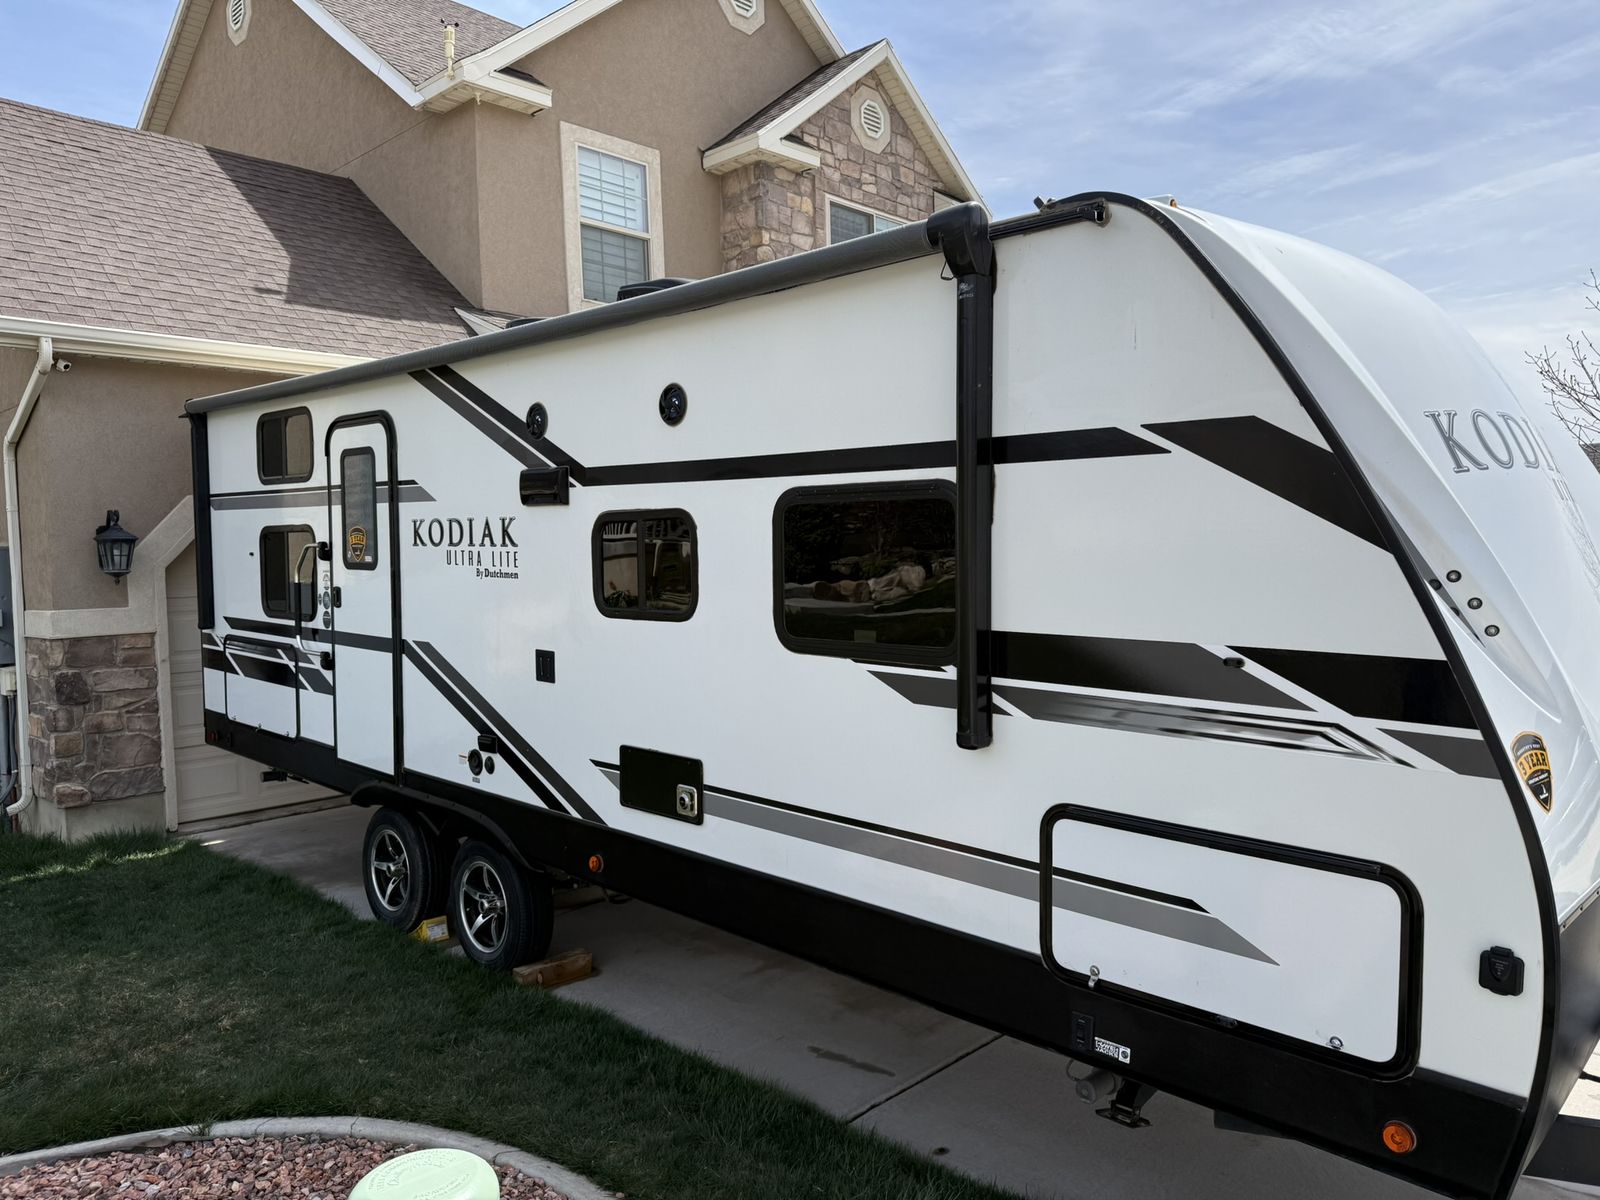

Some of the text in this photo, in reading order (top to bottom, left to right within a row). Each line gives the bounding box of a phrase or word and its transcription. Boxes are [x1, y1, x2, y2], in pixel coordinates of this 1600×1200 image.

[411, 516, 519, 547] KODIAK
[446, 549, 519, 568] ULTRA LITE
[475, 567, 519, 580] By Dutchmen
[1518, 752, 1548, 776] 3 YEAR
